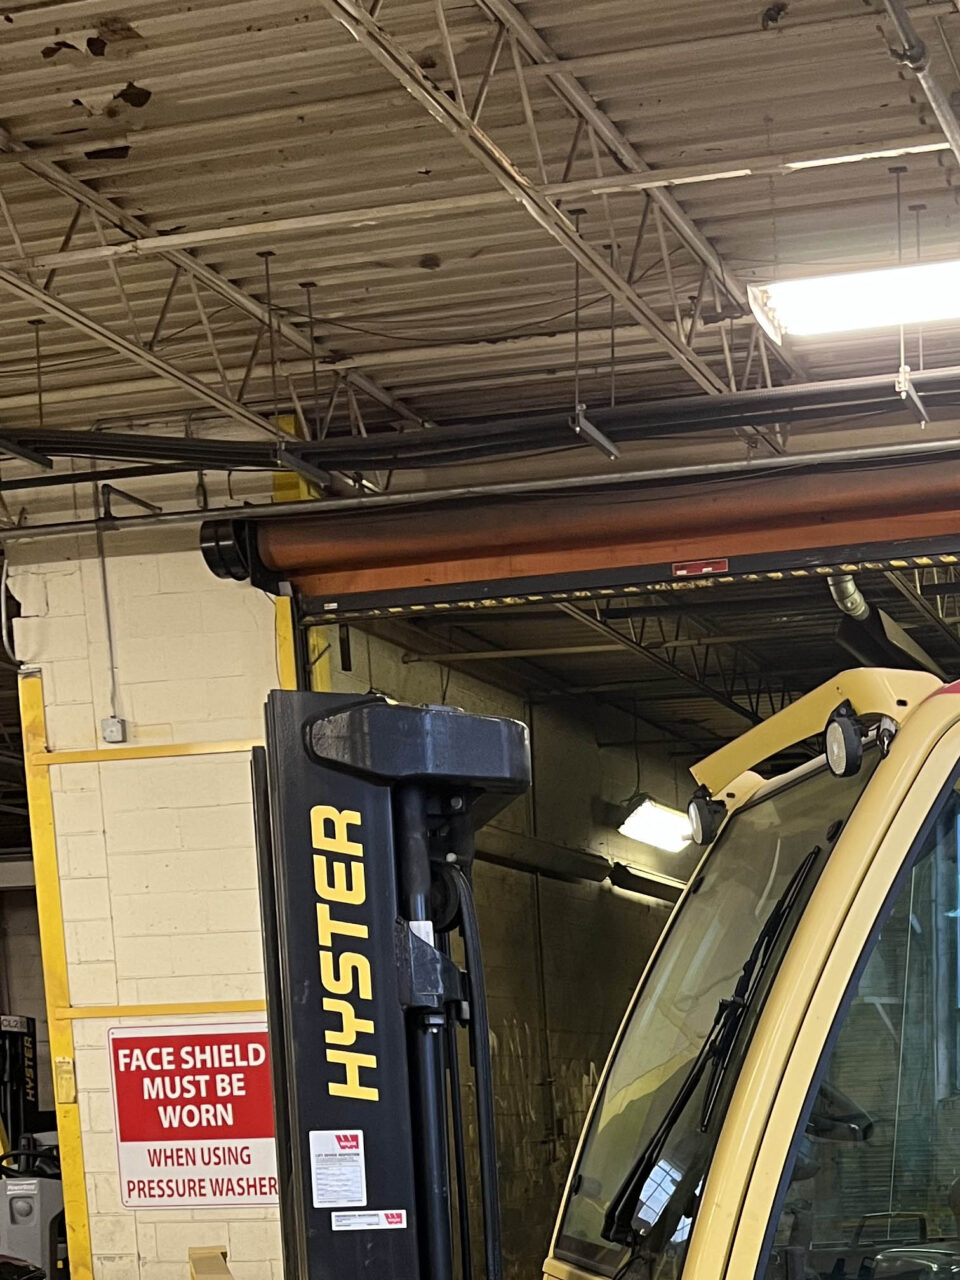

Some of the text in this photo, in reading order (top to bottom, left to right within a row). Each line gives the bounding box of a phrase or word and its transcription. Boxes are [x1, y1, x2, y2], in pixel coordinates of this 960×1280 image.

[310, 805, 379, 1102] HYSTER
[118, 1043, 266, 1072] FACE SHIELD
[143, 1073, 246, 1100] MUST BE
[158, 1103, 233, 1128] WORN
[147, 1146, 251, 1167] WHEN USING
[127, 1177, 279, 1199] PRESSURE WASHER
